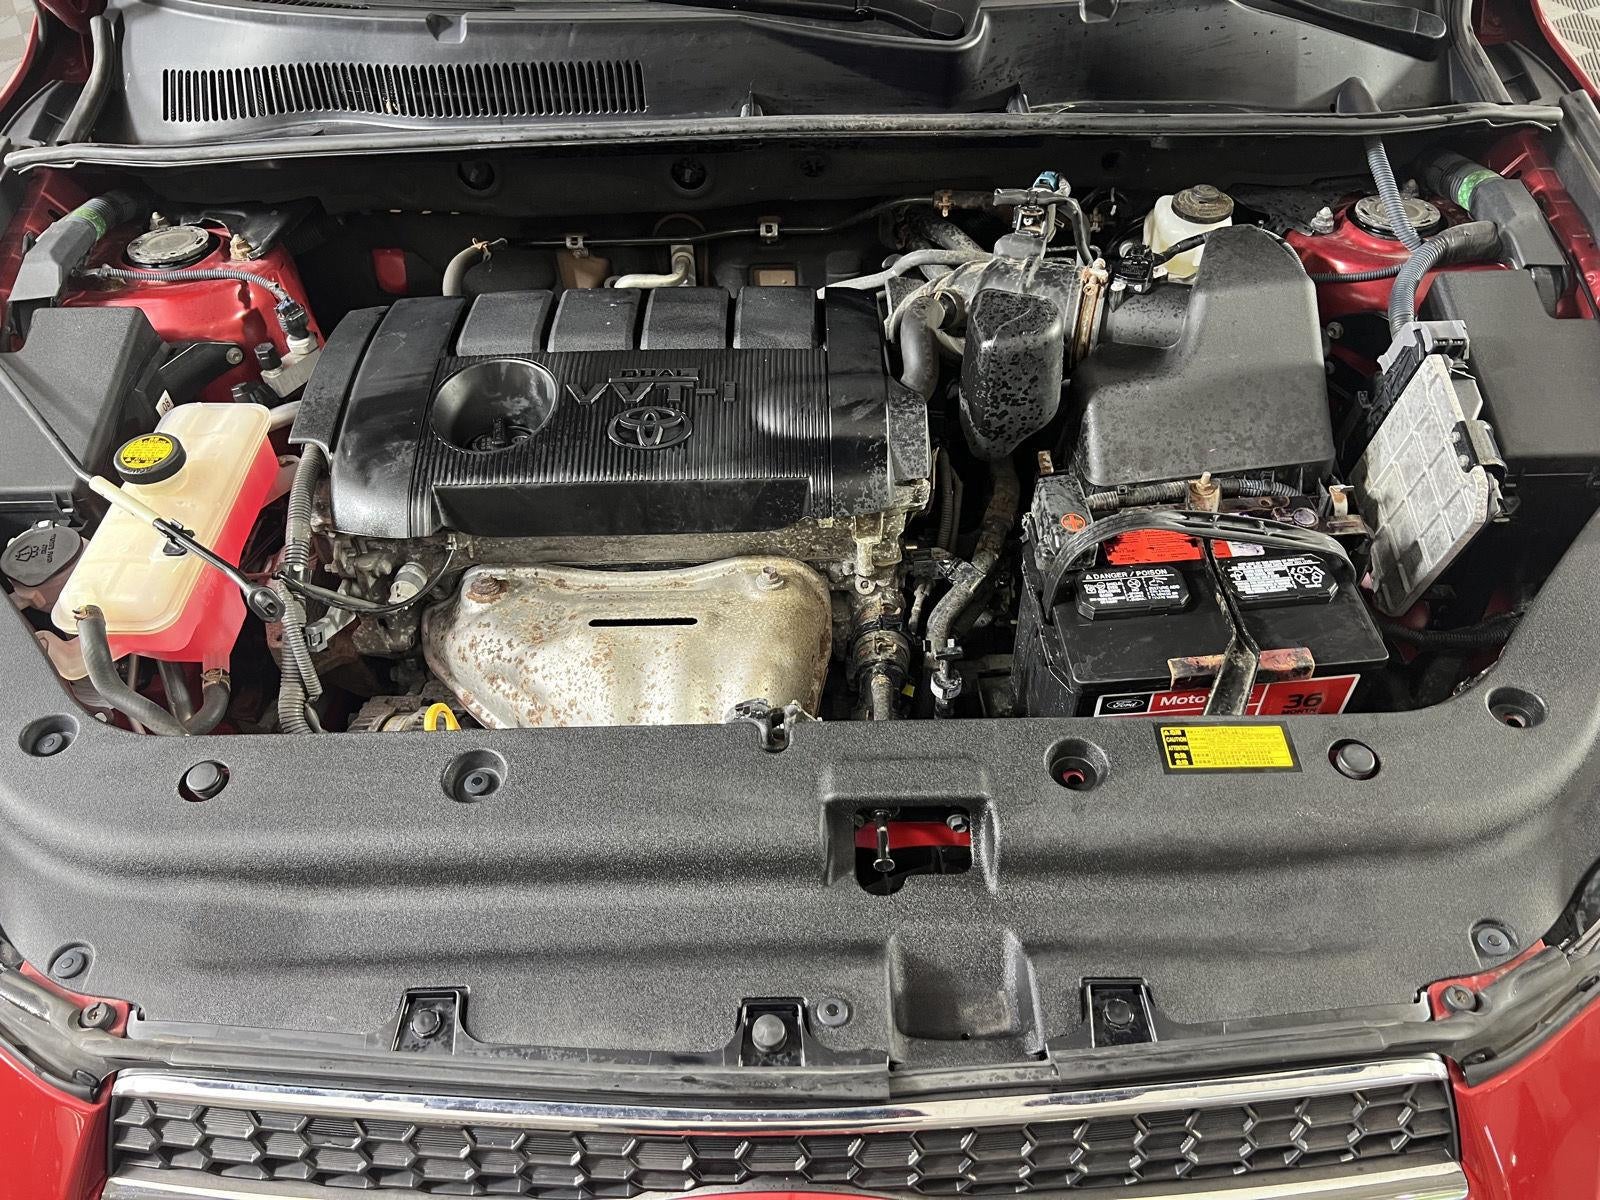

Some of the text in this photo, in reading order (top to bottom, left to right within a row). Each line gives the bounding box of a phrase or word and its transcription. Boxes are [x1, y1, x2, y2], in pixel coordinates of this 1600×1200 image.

[1093, 571, 1128, 580] DANGER
[1136, 568, 1168, 577] POISON
[1112, 700, 1138, 709] Ford
[1282, 692, 1323, 709] 36
